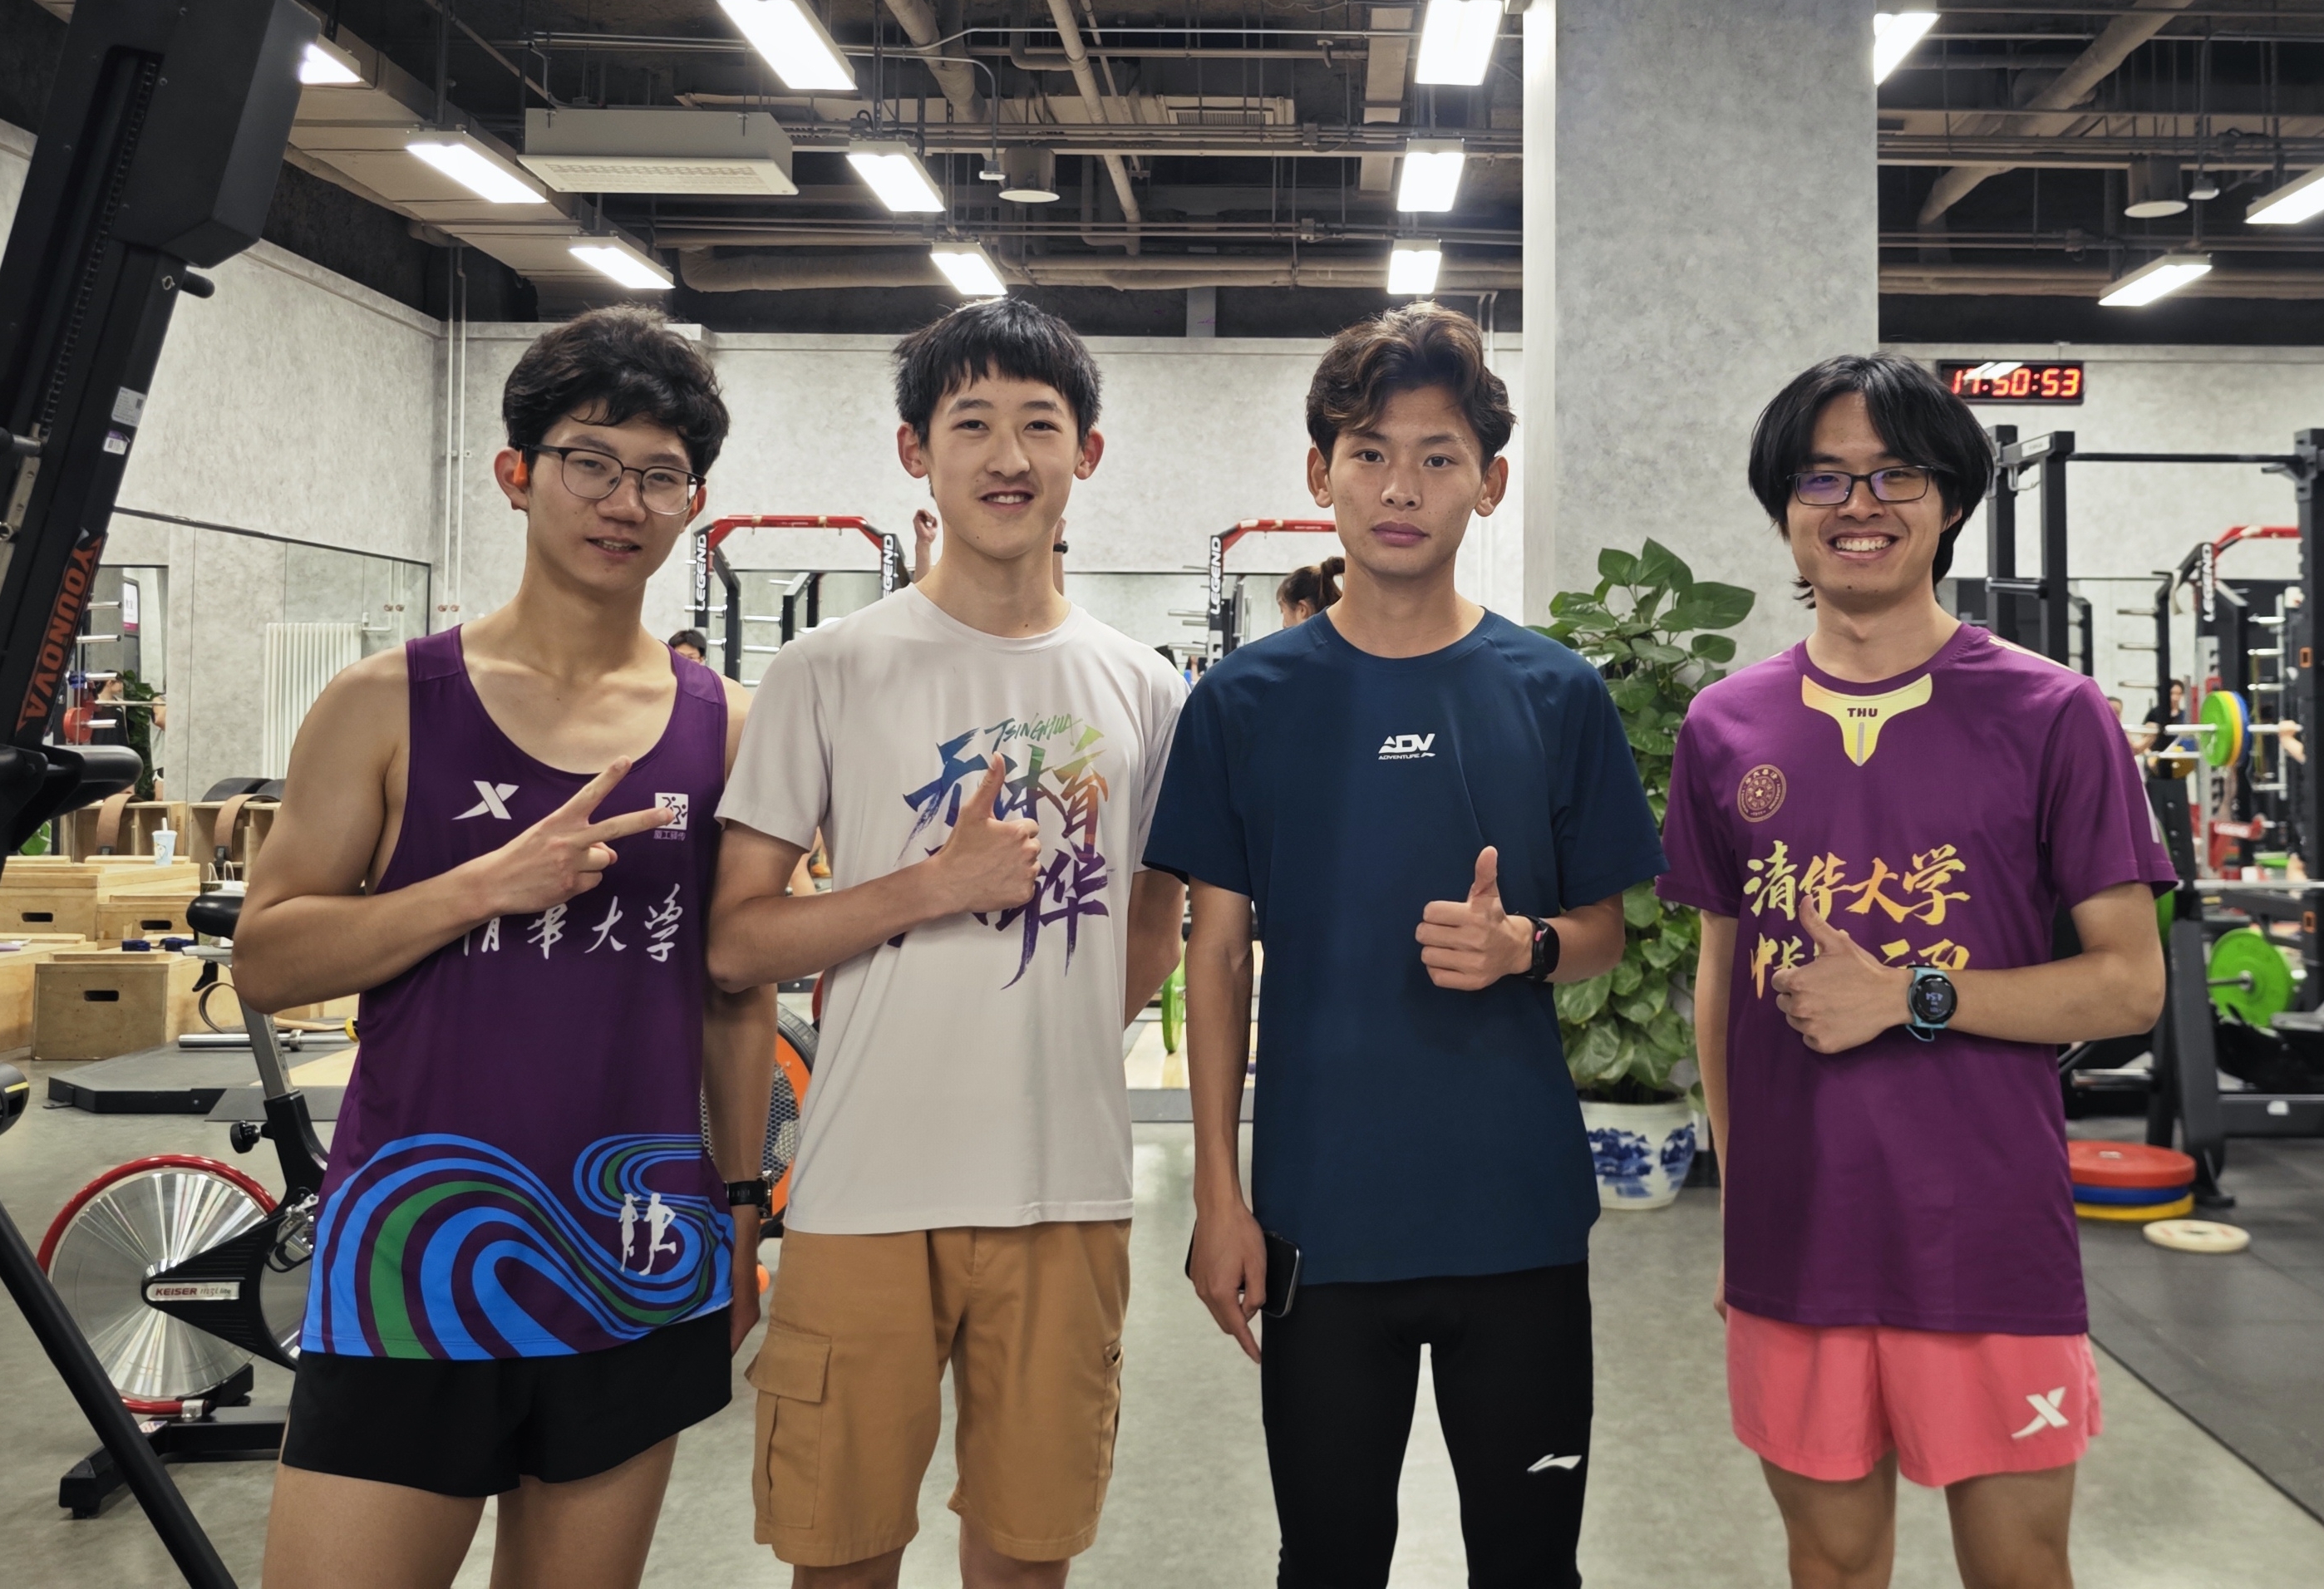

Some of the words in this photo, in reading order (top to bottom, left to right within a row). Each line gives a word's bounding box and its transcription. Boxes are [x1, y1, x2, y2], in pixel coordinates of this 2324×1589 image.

[696, 534, 707, 612] LEGEND
[883, 534, 895, 598] EGEND
[1210, 537, 1222, 615] LEGEND
[25, 537, 103, 719] YOUNOVA
[984, 712, 1083, 755] TSINGHUA
[1378, 733, 1435, 754] ADV
[1846, 707, 1878, 718] THU
[1744, 839, 1971, 925] 清华大学
[155, 1287, 198, 1296] KEISER
